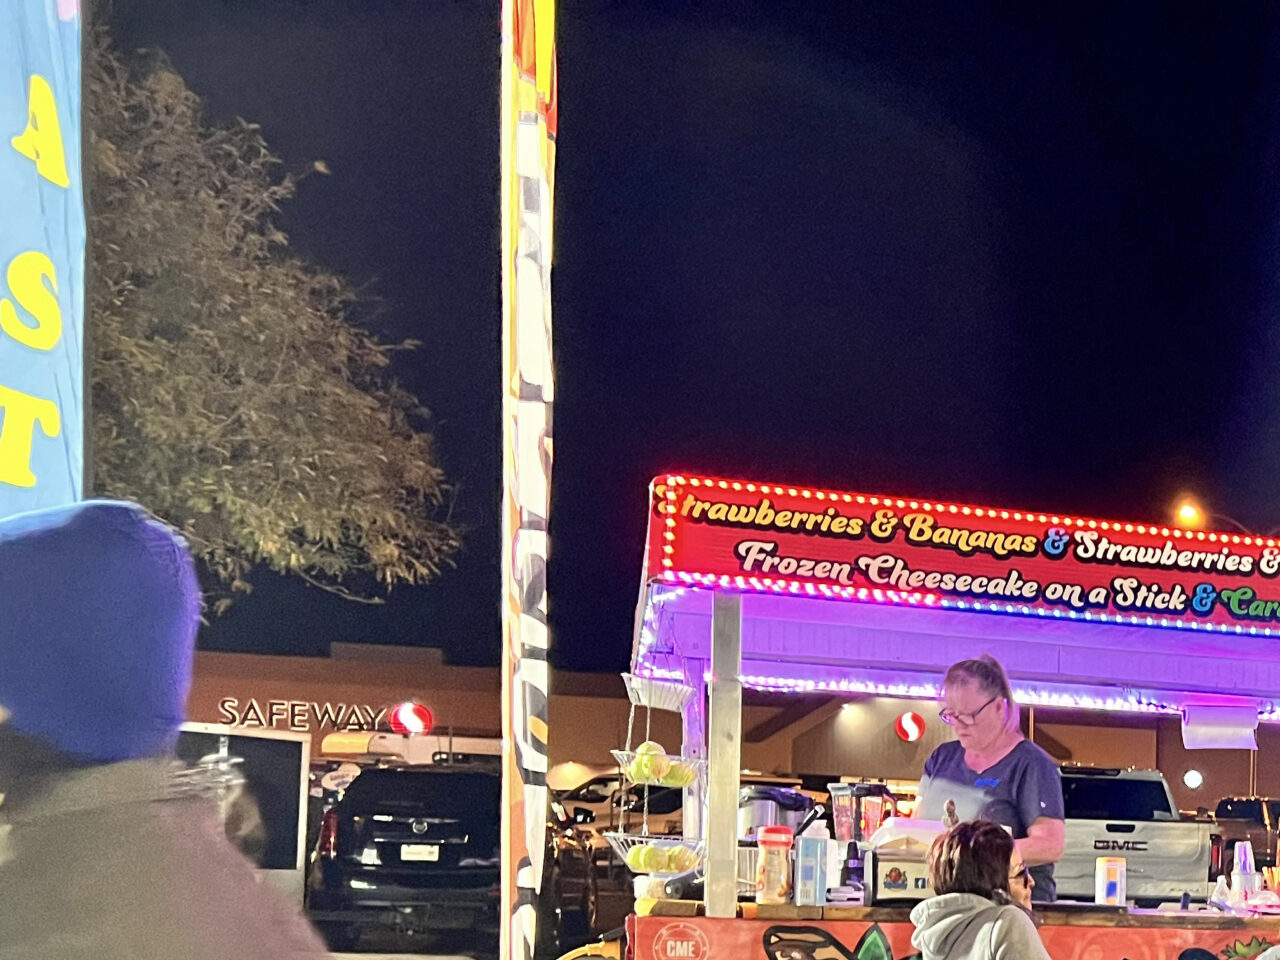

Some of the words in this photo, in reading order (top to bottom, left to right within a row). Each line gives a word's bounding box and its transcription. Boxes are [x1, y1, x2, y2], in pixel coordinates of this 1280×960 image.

[870, 508, 898, 538] &
[903, 512, 1038, 555] Bananas
[1044, 528, 1069, 555] &
[1074, 530, 1254, 573] Strawberries
[738, 541, 854, 586] Frozen
[858, 554, 1038, 599] Cheesecake
[1045, 583, 1084, 608] on
[1089, 587, 1108, 604] a
[1113, 577, 1187, 610] Stick
[1192, 583, 1216, 613] &
[218, 697, 388, 731] SAFEWAY
[1093, 840, 1148, 852] GMC
[666, 939, 696, 958] CME
